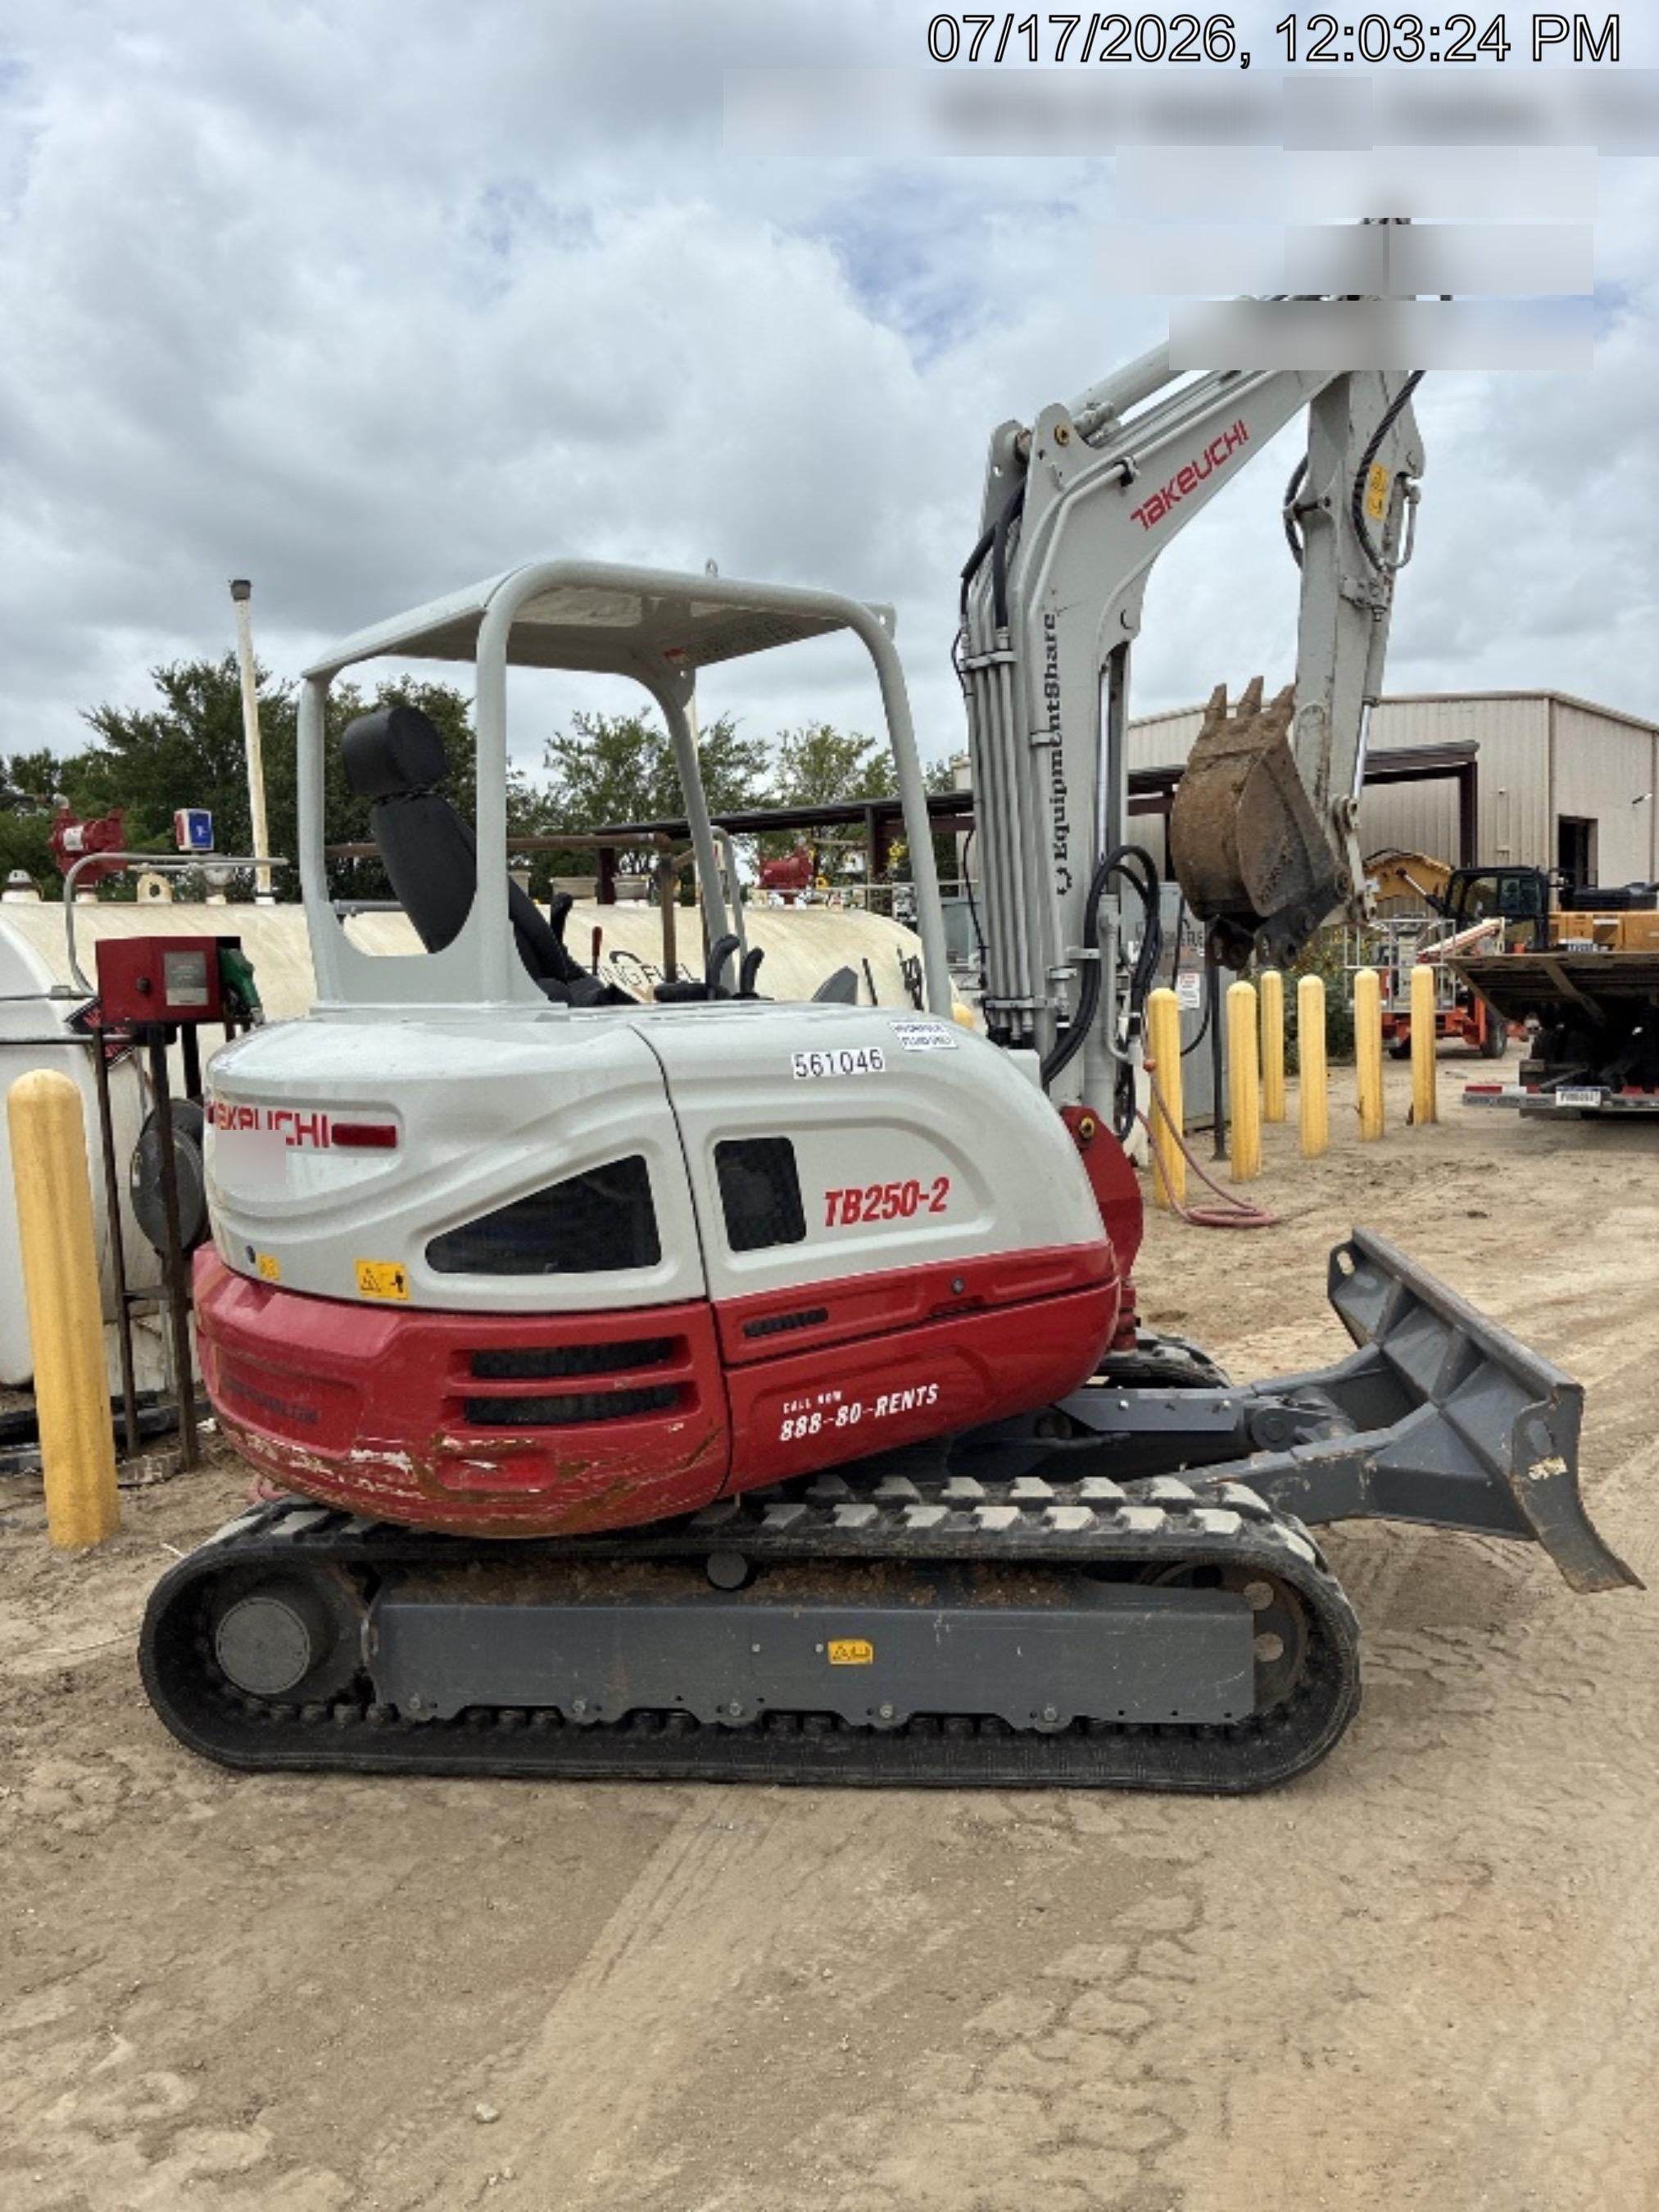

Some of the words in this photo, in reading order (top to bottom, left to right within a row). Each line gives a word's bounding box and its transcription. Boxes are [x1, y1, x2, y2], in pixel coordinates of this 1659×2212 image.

[1043, 613, 1070, 861] EquipmentShare
[795, 1049, 883, 1077] 561046
[824, 1176, 950, 1227] TB250-2
[780, 1383, 940, 1442] 888-80-RENTS
